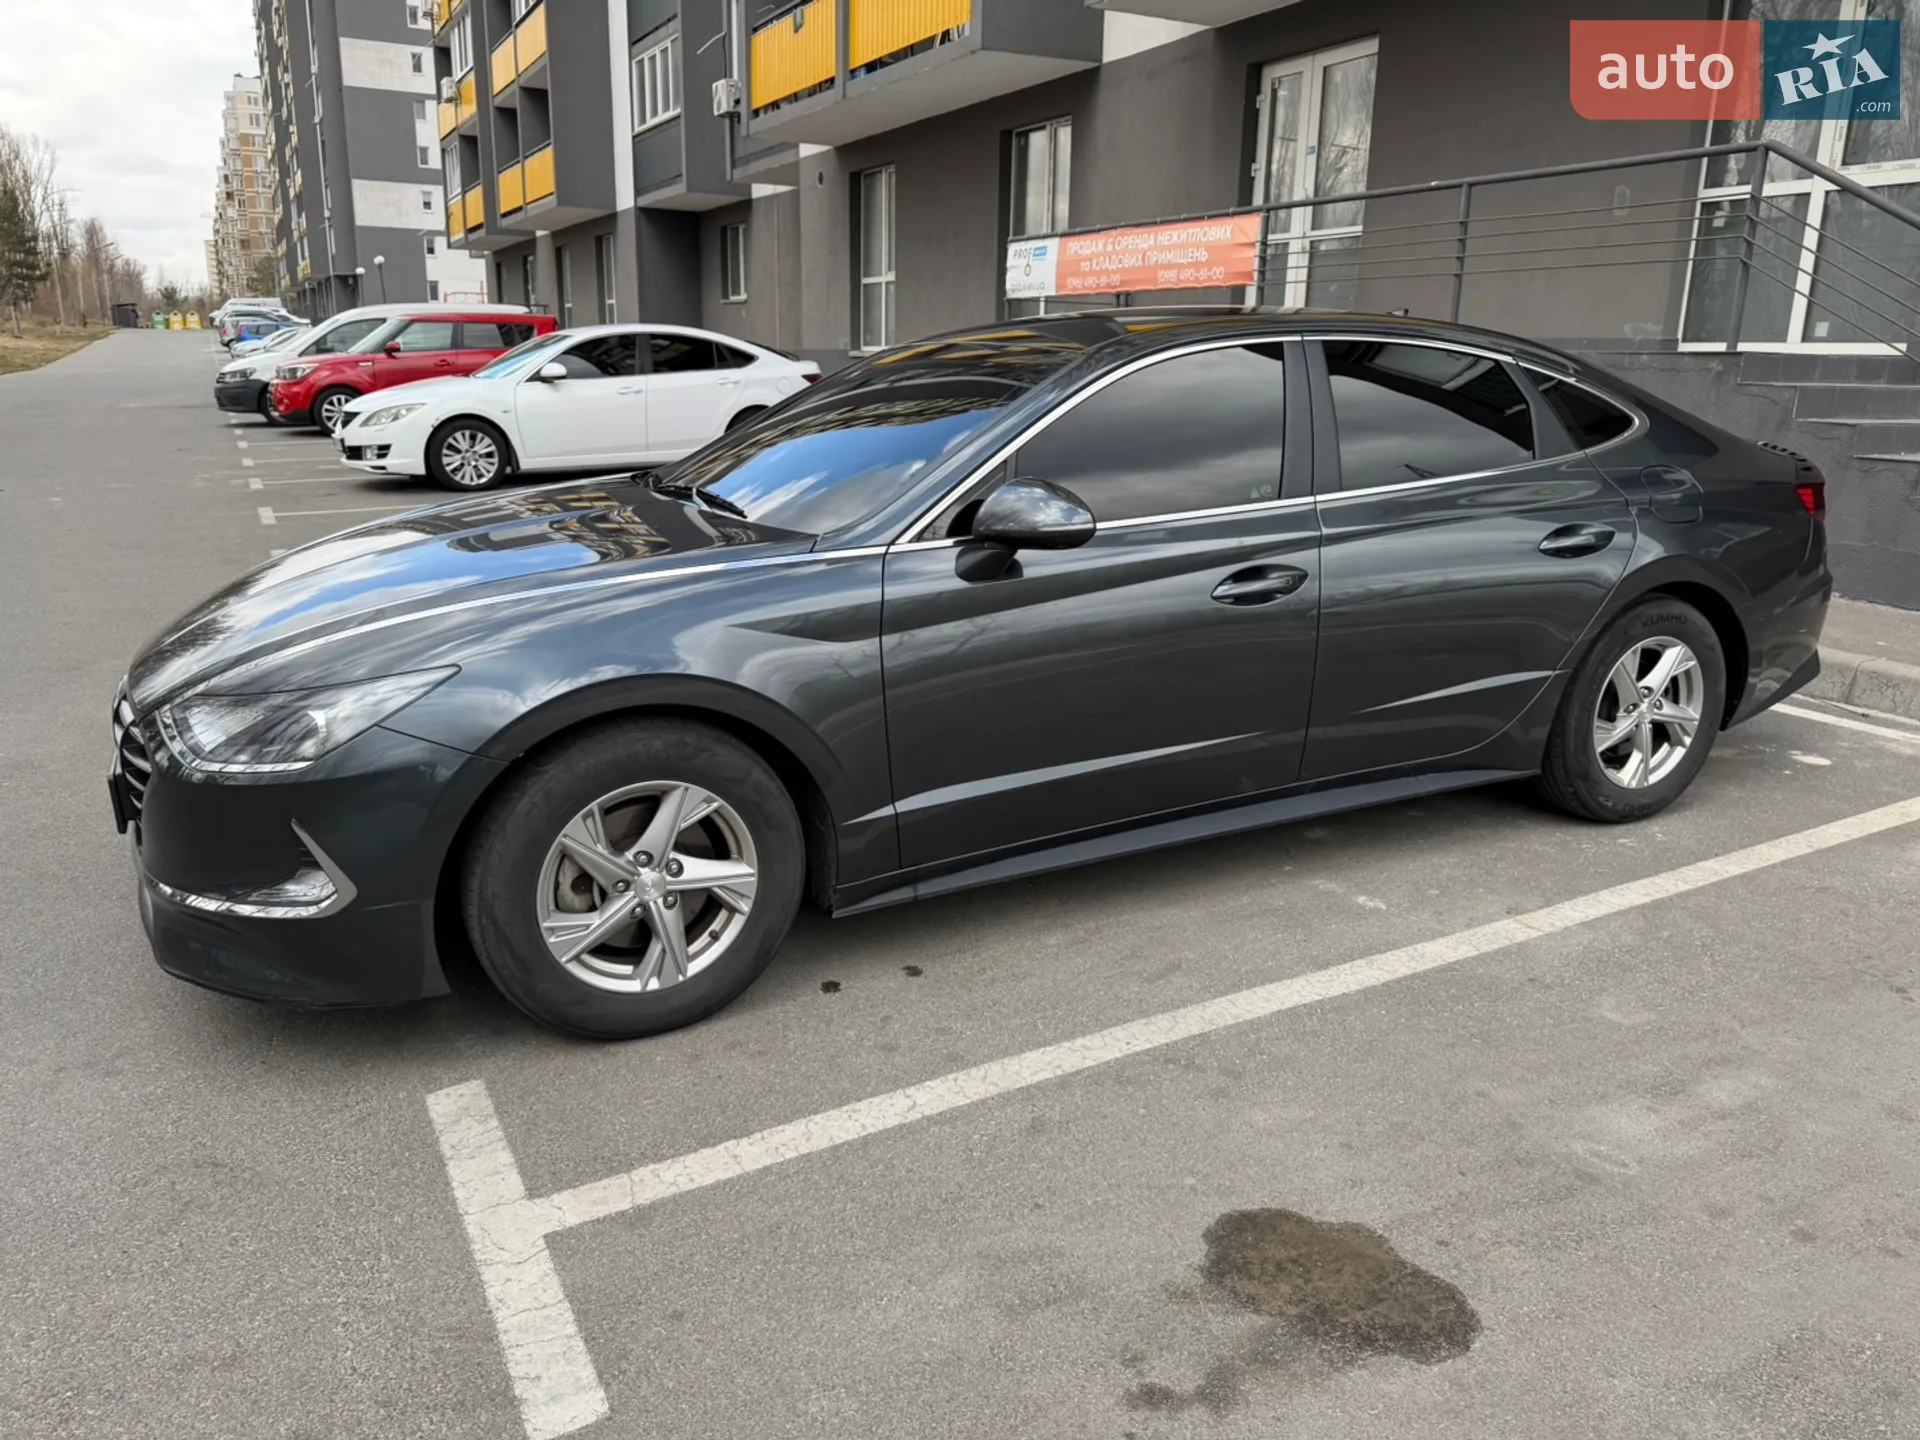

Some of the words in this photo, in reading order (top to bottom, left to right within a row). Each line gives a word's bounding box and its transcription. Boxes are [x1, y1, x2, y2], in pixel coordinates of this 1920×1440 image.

[1067, 240, 1104, 256] ПРОДАЖ
[1115, 234, 1155, 250] ОРЕНДА
[1157, 224, 1233, 246] НЕЖИТЛОВИХ
[1092, 251, 1143, 271] КЛАДОВИХ
[1145, 246, 1209, 266] ПРИМІЩЕНЬ
[1179, 266, 1225, 281] 490-61-00
[1642, 613, 1688, 630] KUMHO
